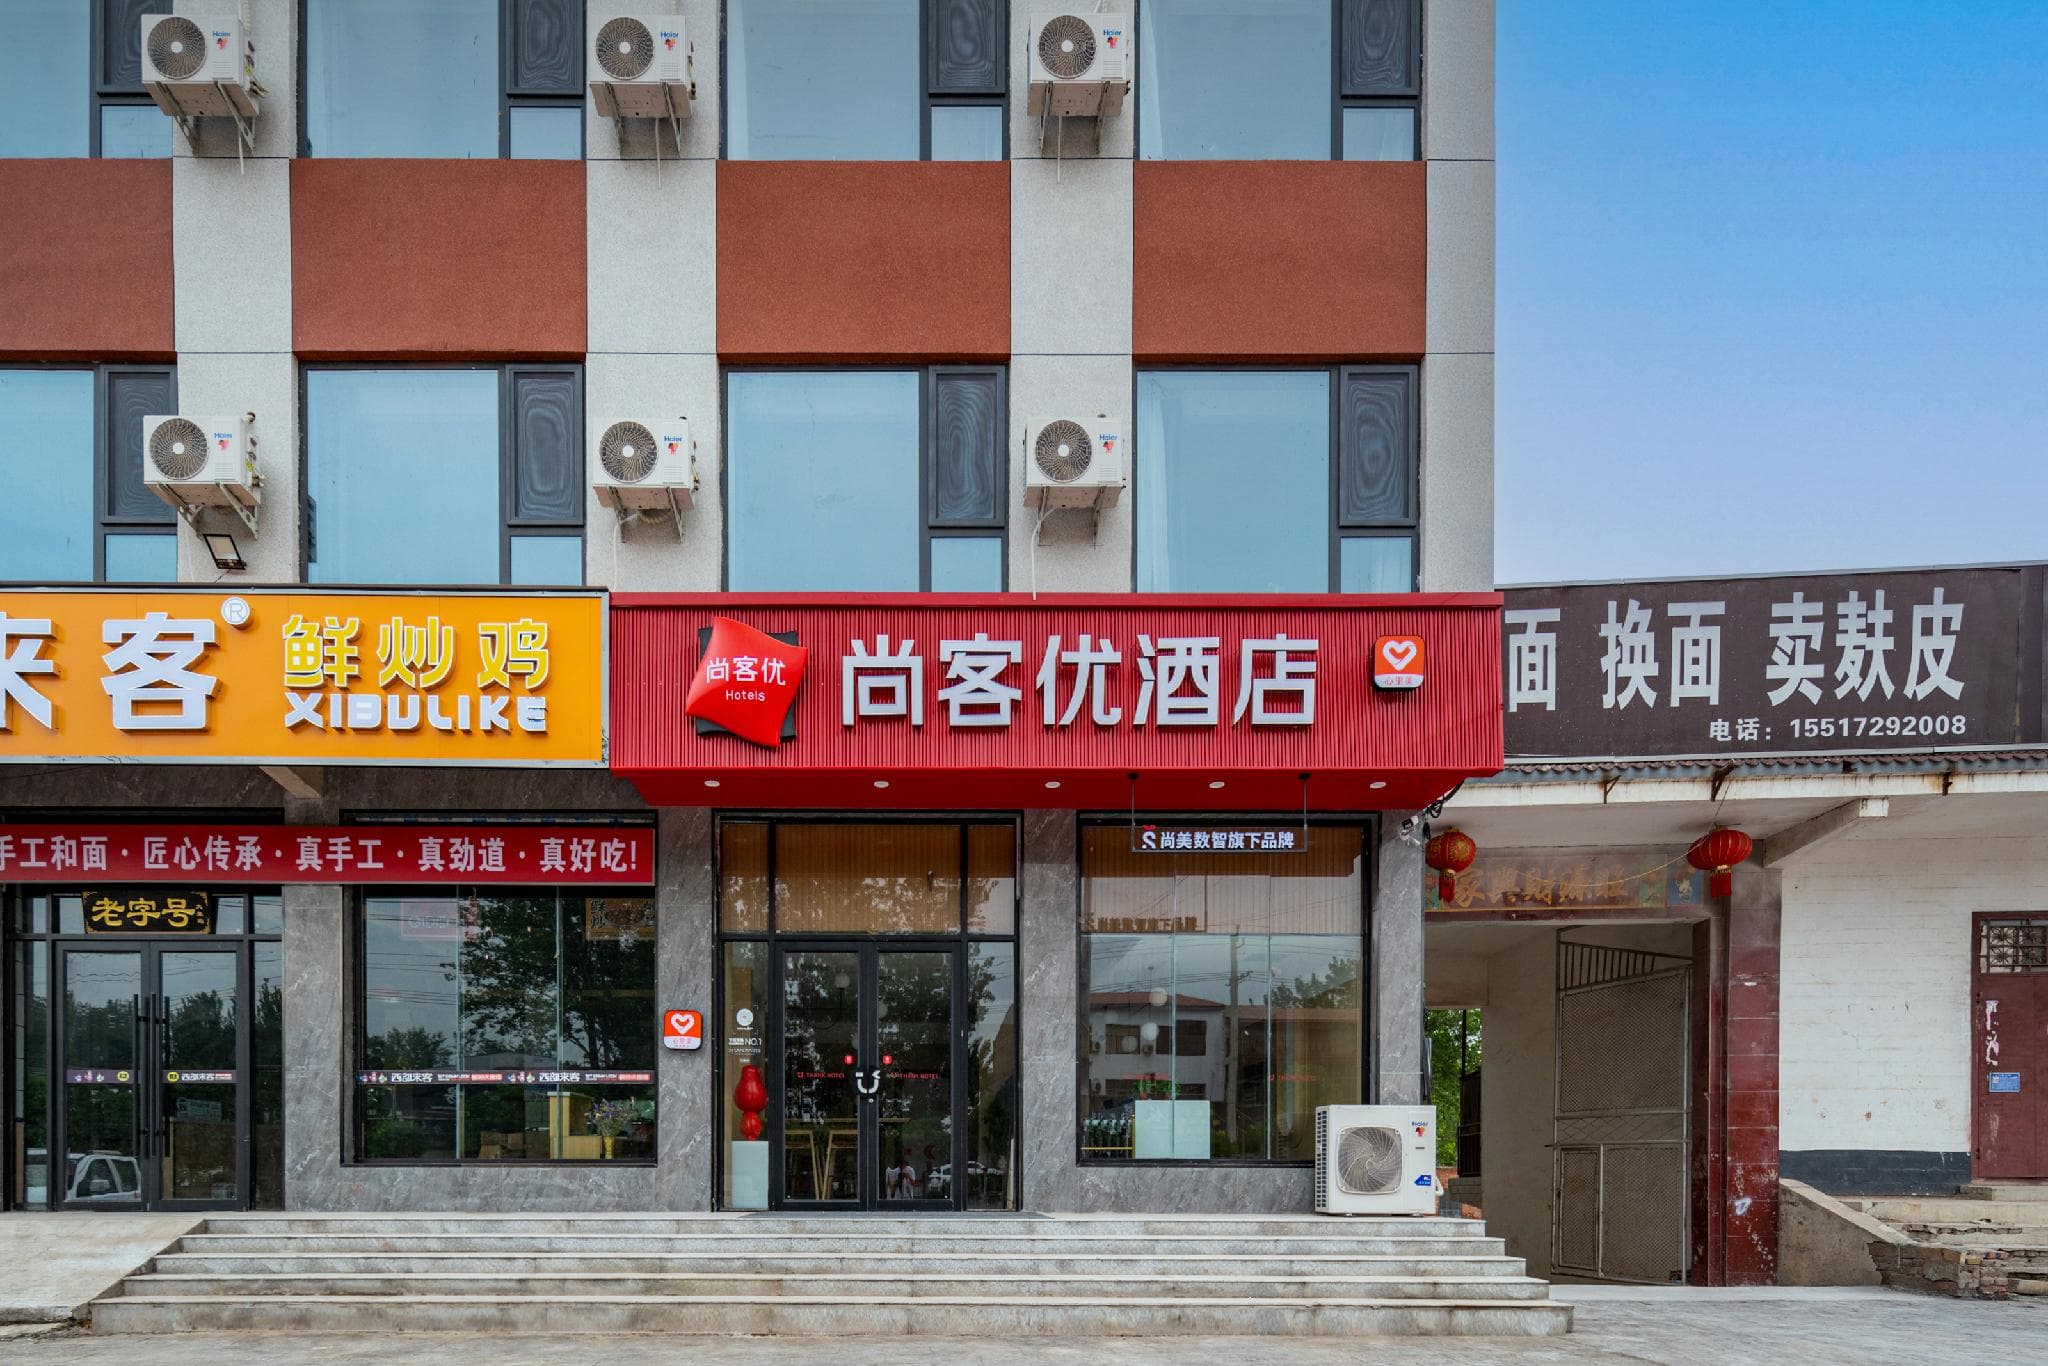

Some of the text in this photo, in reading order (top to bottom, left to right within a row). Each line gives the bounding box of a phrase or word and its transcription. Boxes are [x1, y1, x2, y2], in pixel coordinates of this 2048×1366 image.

[1103, 29, 1122, 37] Haier
[282, 614, 549, 690] 鲜炒鸡
[1599, 598, 1726, 711] 换面
[1765, 587, 1965, 706] 卖麸皮
[705, 655, 787, 686] 尚客优
[842, 633, 1319, 727] 尚客优酒店
[725, 689, 766, 702] Hotels
[283, 692, 548, 732] XIBULIKE
[1790, 715, 1967, 738] 15517292008
[1160, 831, 1295, 849] 尚美数智旗下品牌
[91, 897, 196, 928] 老字号
